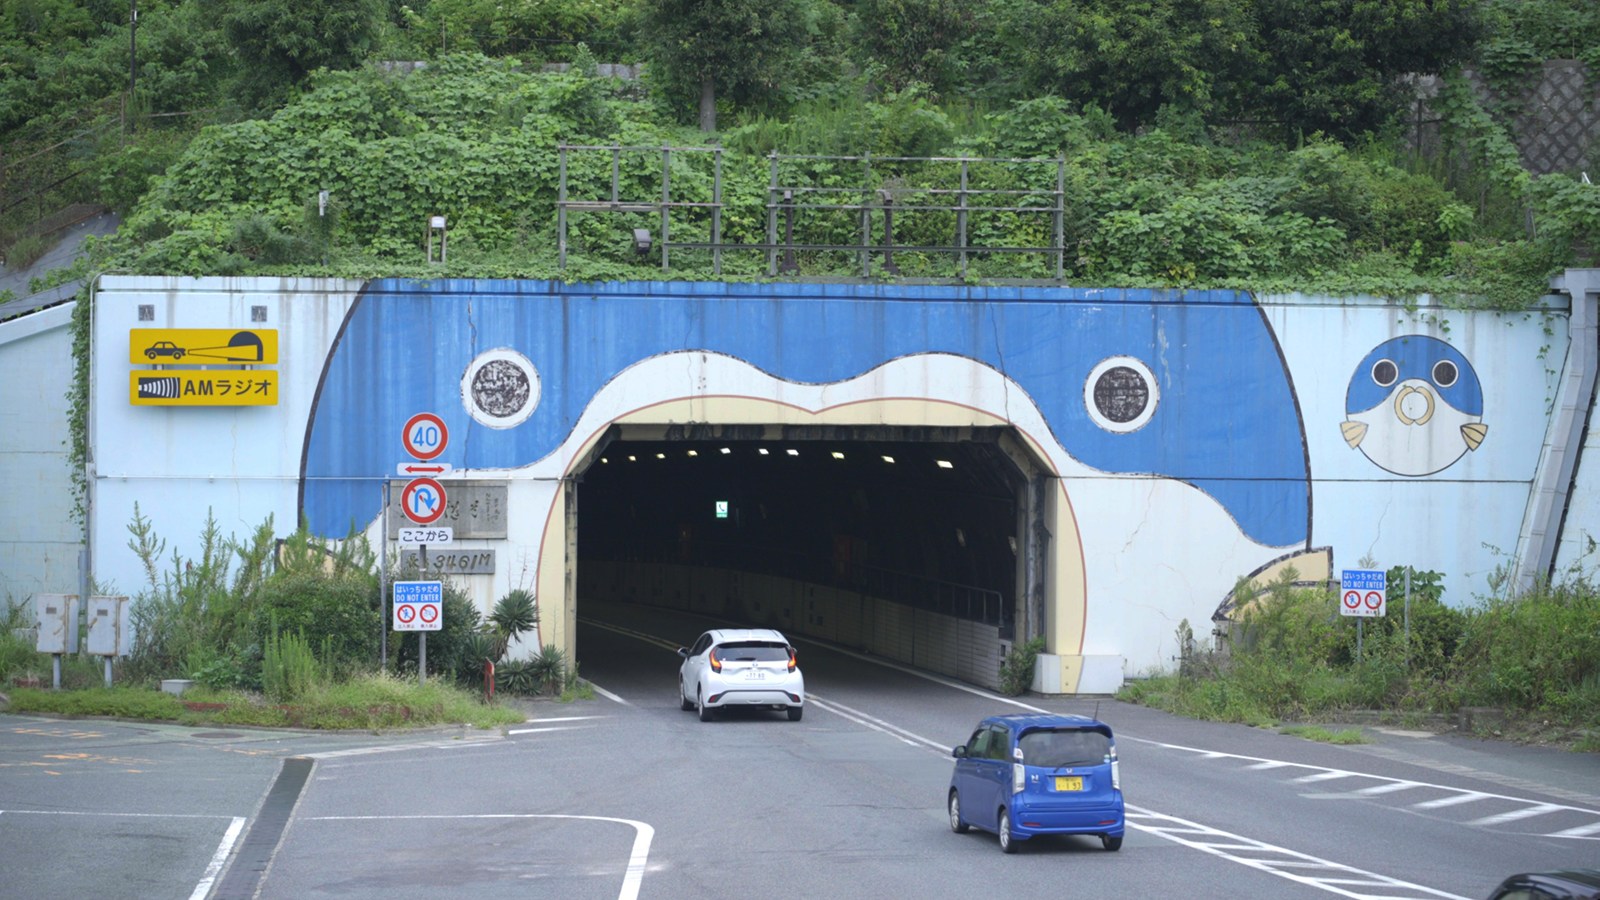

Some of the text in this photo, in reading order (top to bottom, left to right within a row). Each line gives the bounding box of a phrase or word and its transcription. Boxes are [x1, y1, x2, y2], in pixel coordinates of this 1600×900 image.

[183, 379, 272, 397] AMラジオ
[413, 426, 437, 447] 40
[402, 530, 449, 542] ここから
[1343, 572, 1383, 581] はいっちゃだめ
[1343, 580, 1383, 589] DO NOT ENTER
[396, 585, 440, 594] はいっちゃだめ
[396, 593, 439, 602] DO NOT ENTER
